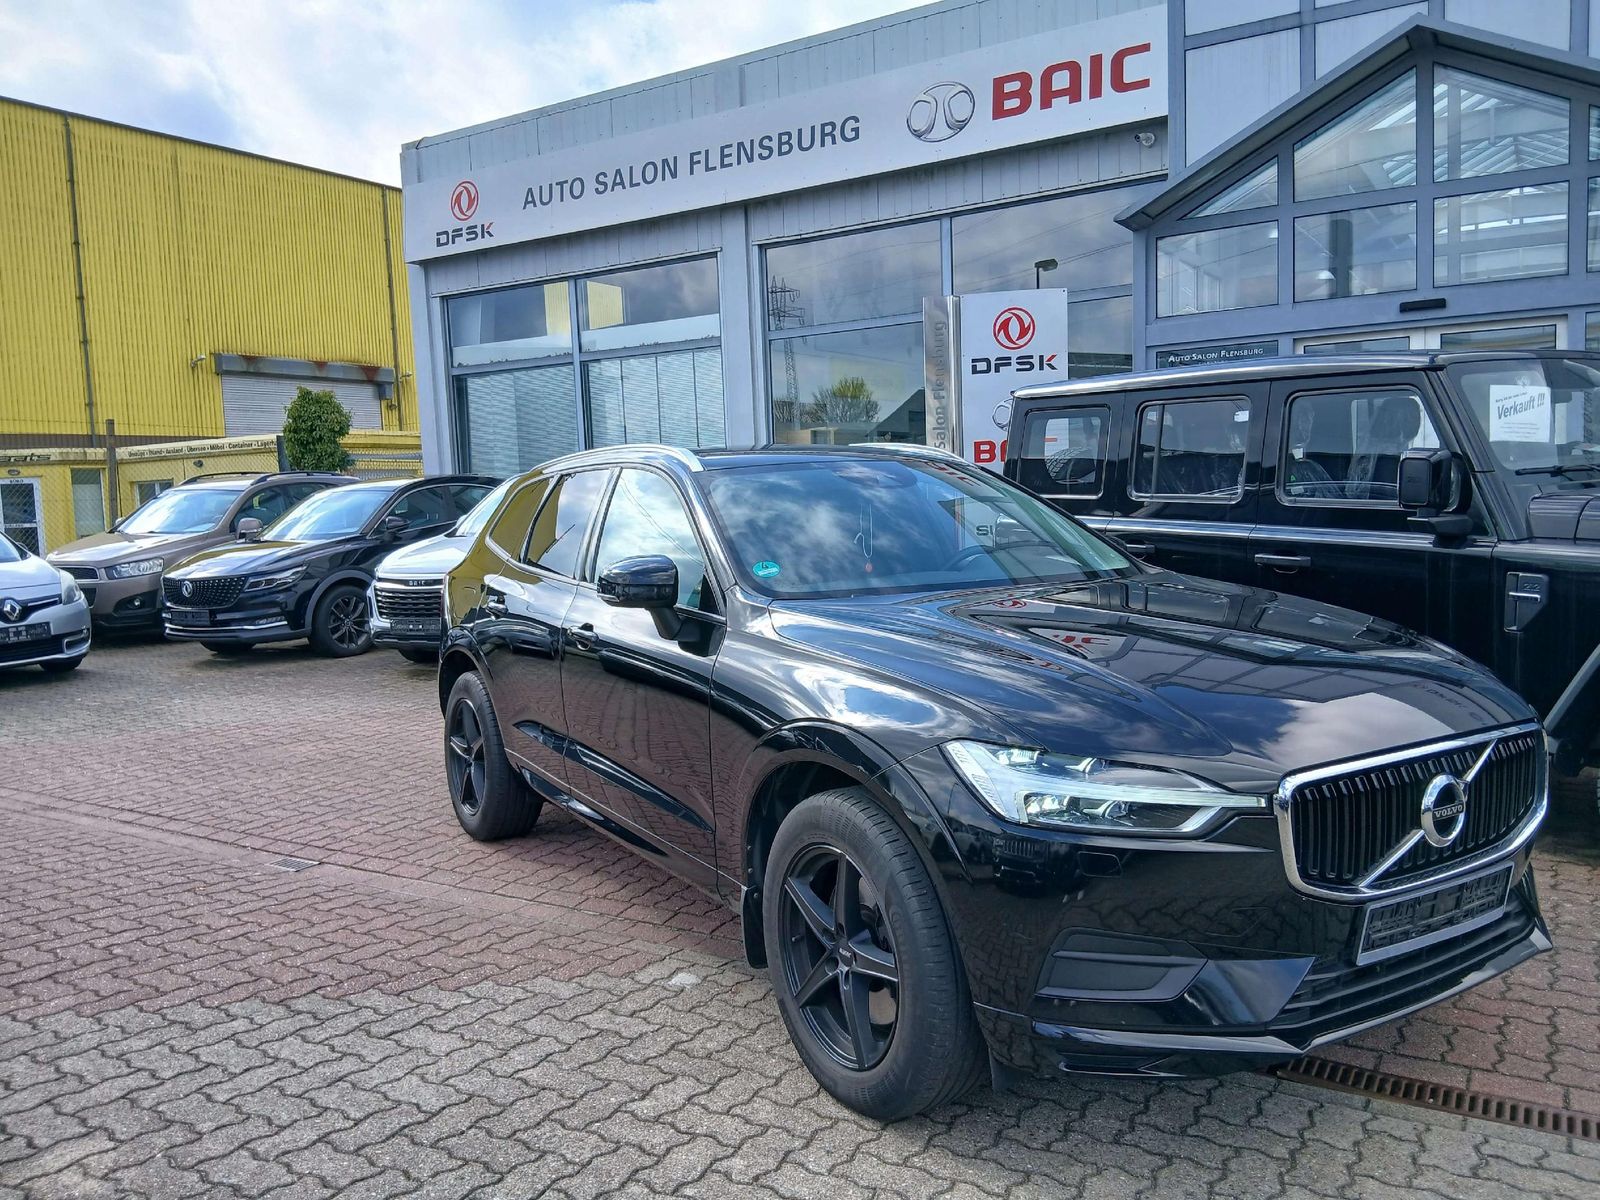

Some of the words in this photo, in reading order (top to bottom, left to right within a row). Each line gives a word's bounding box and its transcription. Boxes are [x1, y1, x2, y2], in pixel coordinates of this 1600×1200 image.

[992, 43, 1150, 120] BAIC
[523, 177, 585, 210] AUTO
[594, 156, 678, 195] SALON
[689, 115, 860, 175] FLENSBURG
[436, 222, 494, 247] DFSK
[931, 321, 947, 400] Flensburg
[971, 354, 1058, 375] DFSK
[1497, 394, 1535, 420] Verkauft
[932, 406, 946, 449] Salon
[1434, 804, 1463, 818] VOLVO
